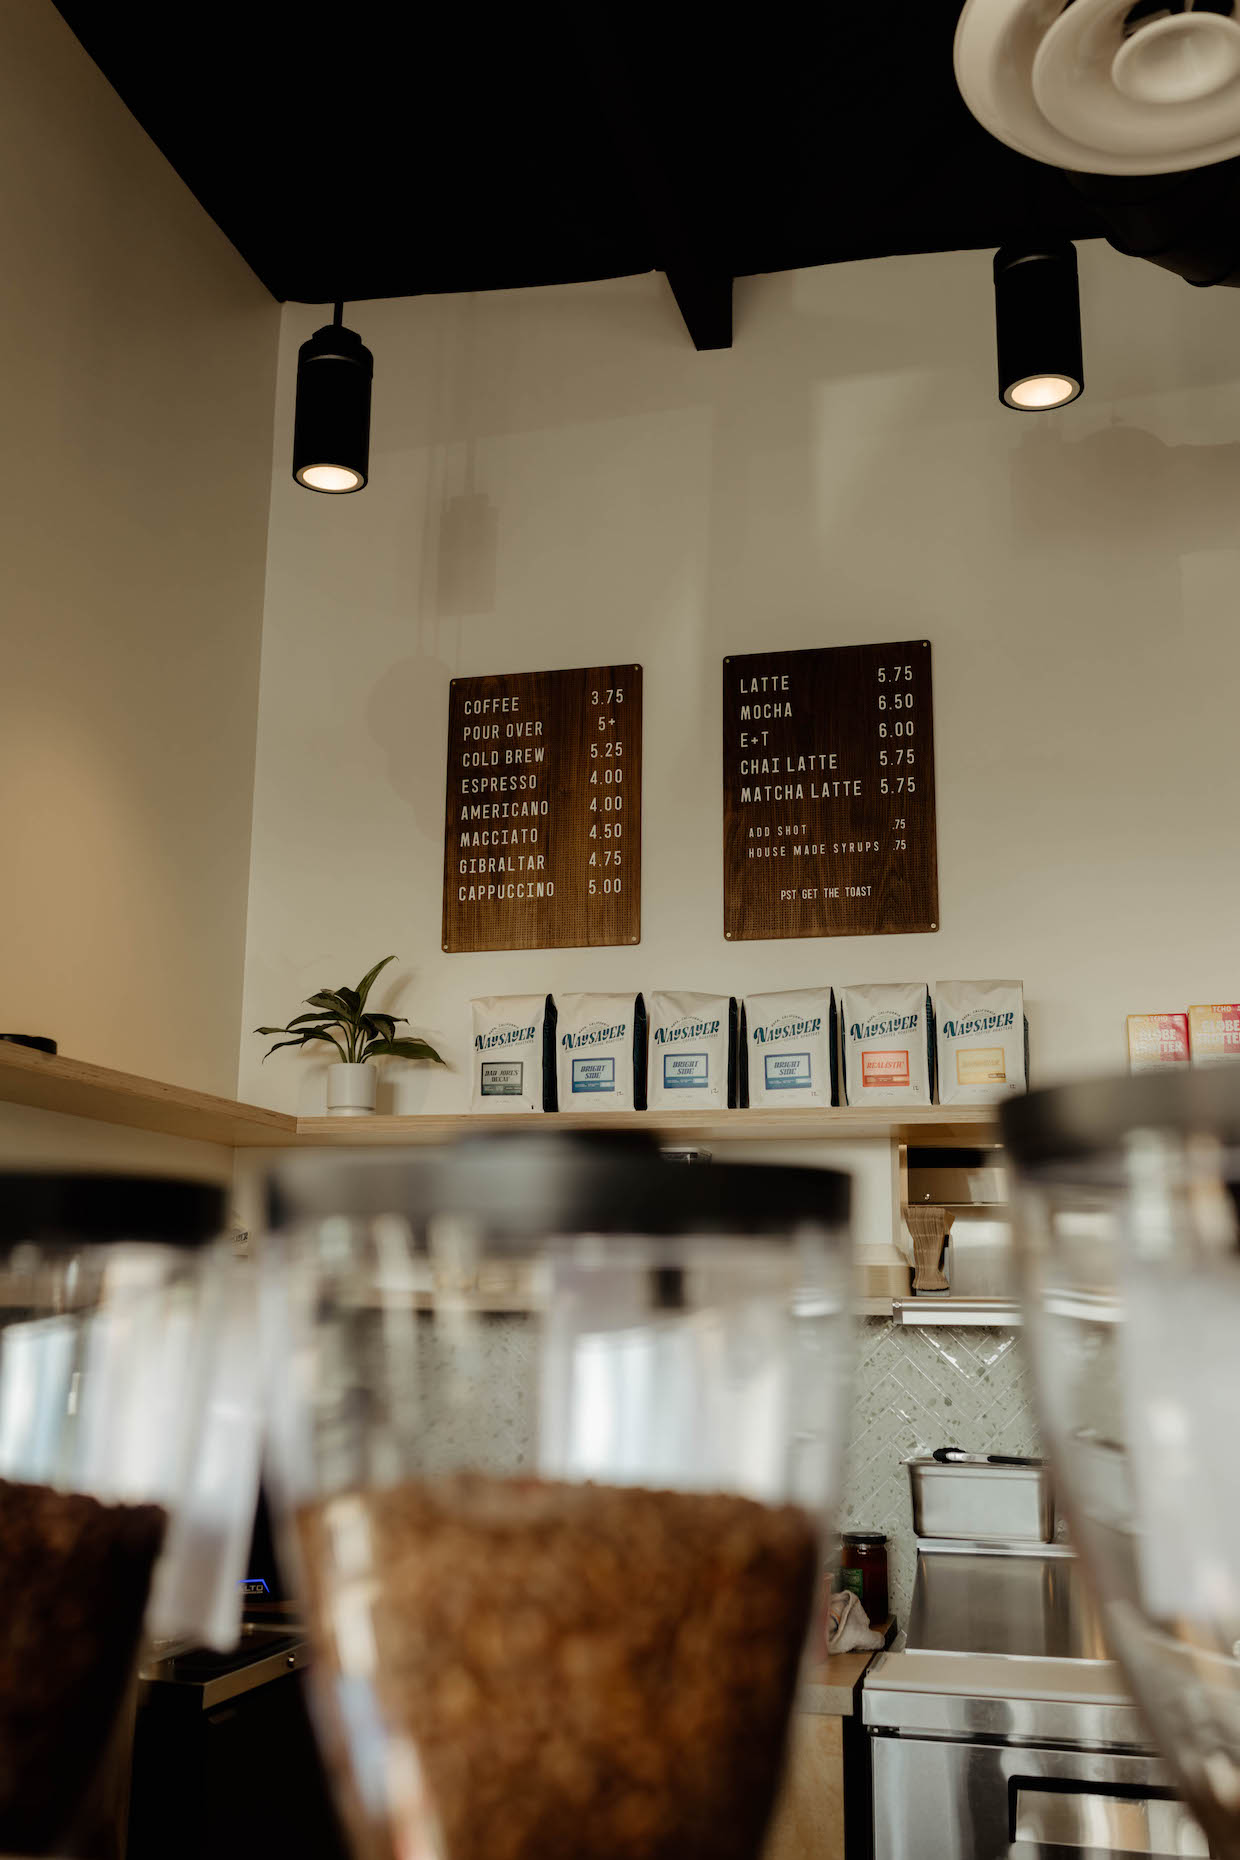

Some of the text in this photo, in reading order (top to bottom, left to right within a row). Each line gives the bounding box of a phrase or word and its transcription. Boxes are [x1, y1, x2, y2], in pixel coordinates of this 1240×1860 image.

[878, 666, 912, 682] 5.75
[741, 676, 789, 693] LATTE
[592, 689, 623, 705] 3.75
[879, 694, 913, 710] 6.50
[465, 697, 519, 714] COFFEE
[741, 703, 792, 720] MOCHA
[464, 722, 542, 740] POUR OVER
[599, 717, 615, 731] 5+
[879, 721, 914, 737] 6.00
[741, 731, 768, 747] E+T
[463, 748, 544, 767] COLD BREW
[591, 742, 622, 758] 5.25
[880, 749, 914, 765] 5.75
[741, 754, 837, 774] CHAI LATTE
[462, 775, 536, 793] ESPRESSO
[590, 769, 622, 784] 4.00
[741, 781, 861, 802] MATCHA LATTE
[881, 777, 915, 794] 5.75
[461, 801, 547, 820] AMERICANO
[590, 796, 621, 811] 4.00
[590, 823, 621, 839] 4.50
[749, 825, 806, 837] ADD SHOT
[893, 819, 905, 829] .75
[461, 829, 537, 847] MACCIATO
[893, 840, 906, 850] .75
[749, 841, 878, 858] HOUSE MADE SYRUPS
[460, 855, 544, 873] GIBRALTAR
[589, 851, 621, 866] 4.75
[459, 882, 553, 901] CAPPUCCINO
[589, 879, 621, 894] 5.00
[781, 886, 871, 900] PST GET THE TOAST
[673, 1060, 699, 1068] BRIGHT
[866, 1061, 905, 1069] REALISTIC
